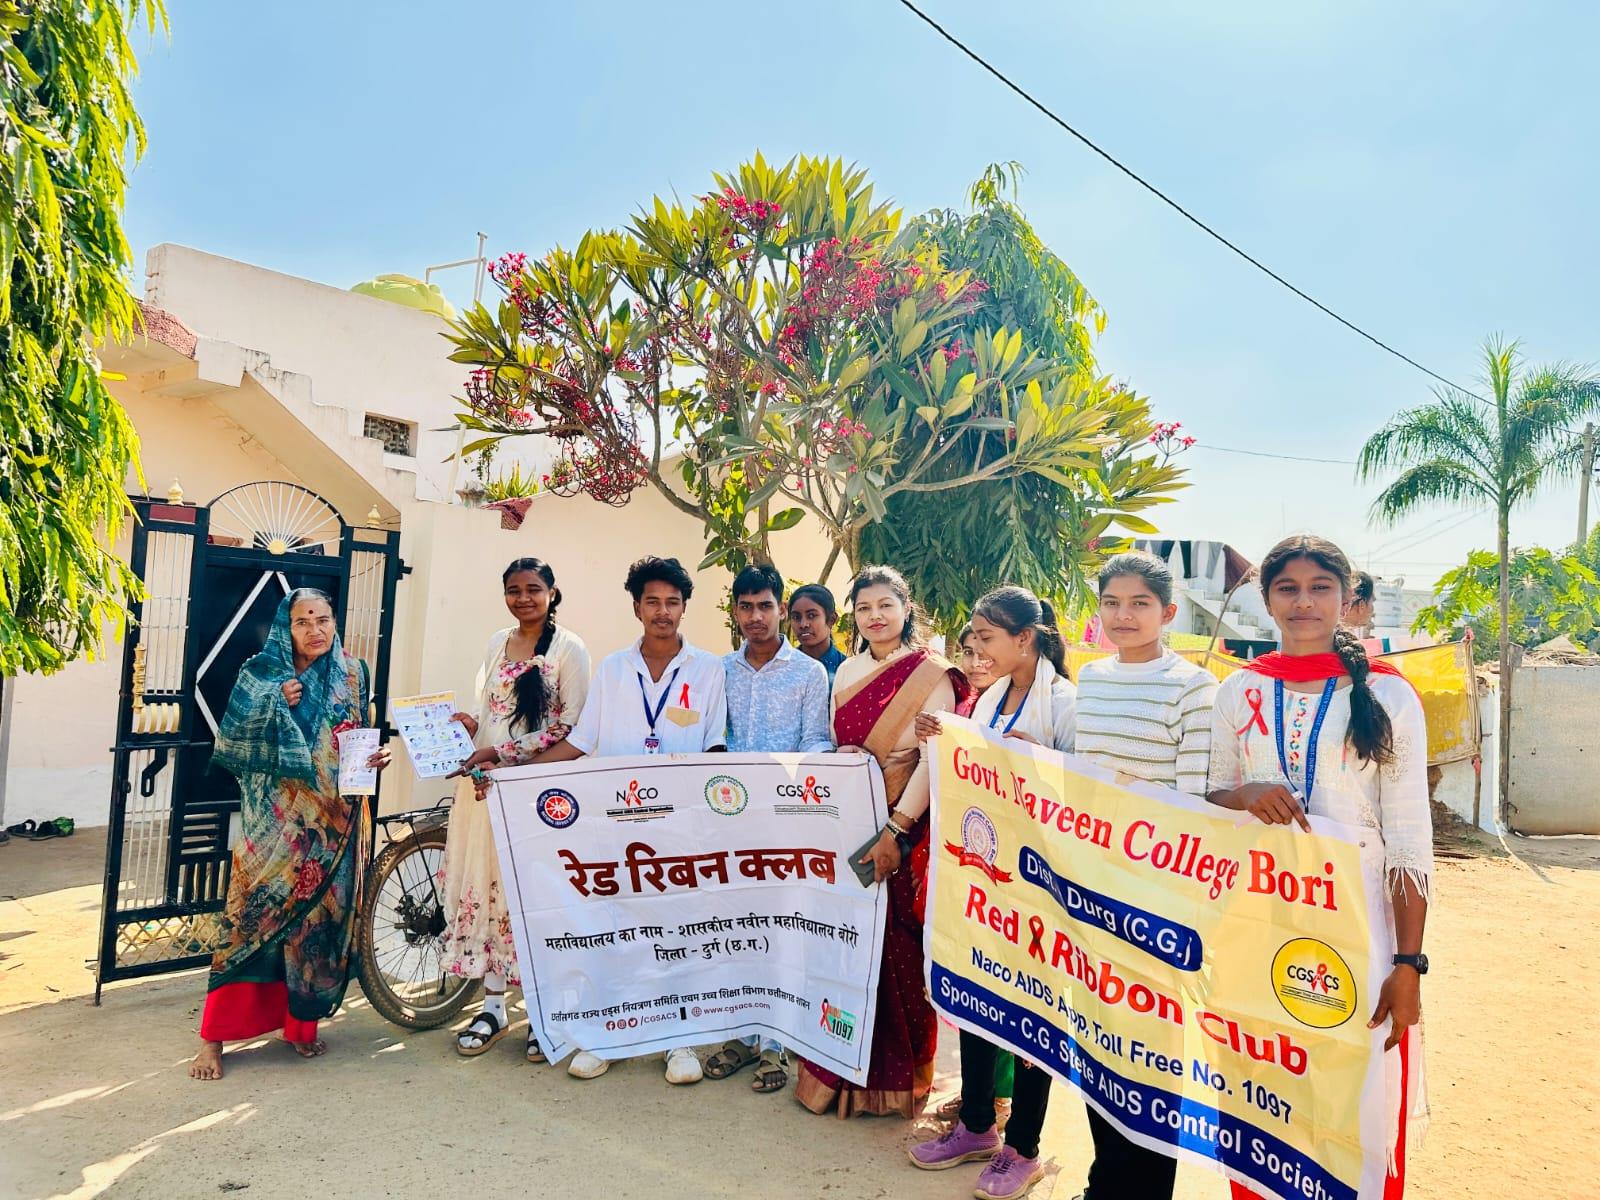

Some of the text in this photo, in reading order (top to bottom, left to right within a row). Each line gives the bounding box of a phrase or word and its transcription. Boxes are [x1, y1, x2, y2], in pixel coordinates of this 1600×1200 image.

[953, 746, 1338, 911] Govt. Naveen College Bori
[558, 841, 836, 897] रेड रिबन क्लब
[545, 933, 615, 951] महाविद्यालय
[619, 928, 637, 942] का
[640, 926, 664, 938] नाम
[678, 916, 734, 938] शासकीय
[736, 912, 770, 929] नवीन
[774, 912, 836, 940] महाविद्यालय
[838, 923, 859, 948] बोरी
[654, 944, 687, 961] जिला
[702, 938, 721, 959] दुर्ग
[725, 936, 770, 955] (छ.ग.)
[1067, 886, 1117, 932] Durg
[1123, 913, 1193, 966] (C.G.)
[965, 884, 1308, 1076] Red Ribbon Club
[1287, 963, 1340, 994] CGSACS
[832, 1018, 854, 1041] 1097
[972, 946, 1292, 1124] Naco AIDS App, Toll Free No. 1097
[940, 976, 1006, 1027] Sponsor
[1021, 1017, 1054, 1054] C.G.
[1098, 1072, 1142, 1115] AIDS
[1151, 1098, 1241, 1153] Control
